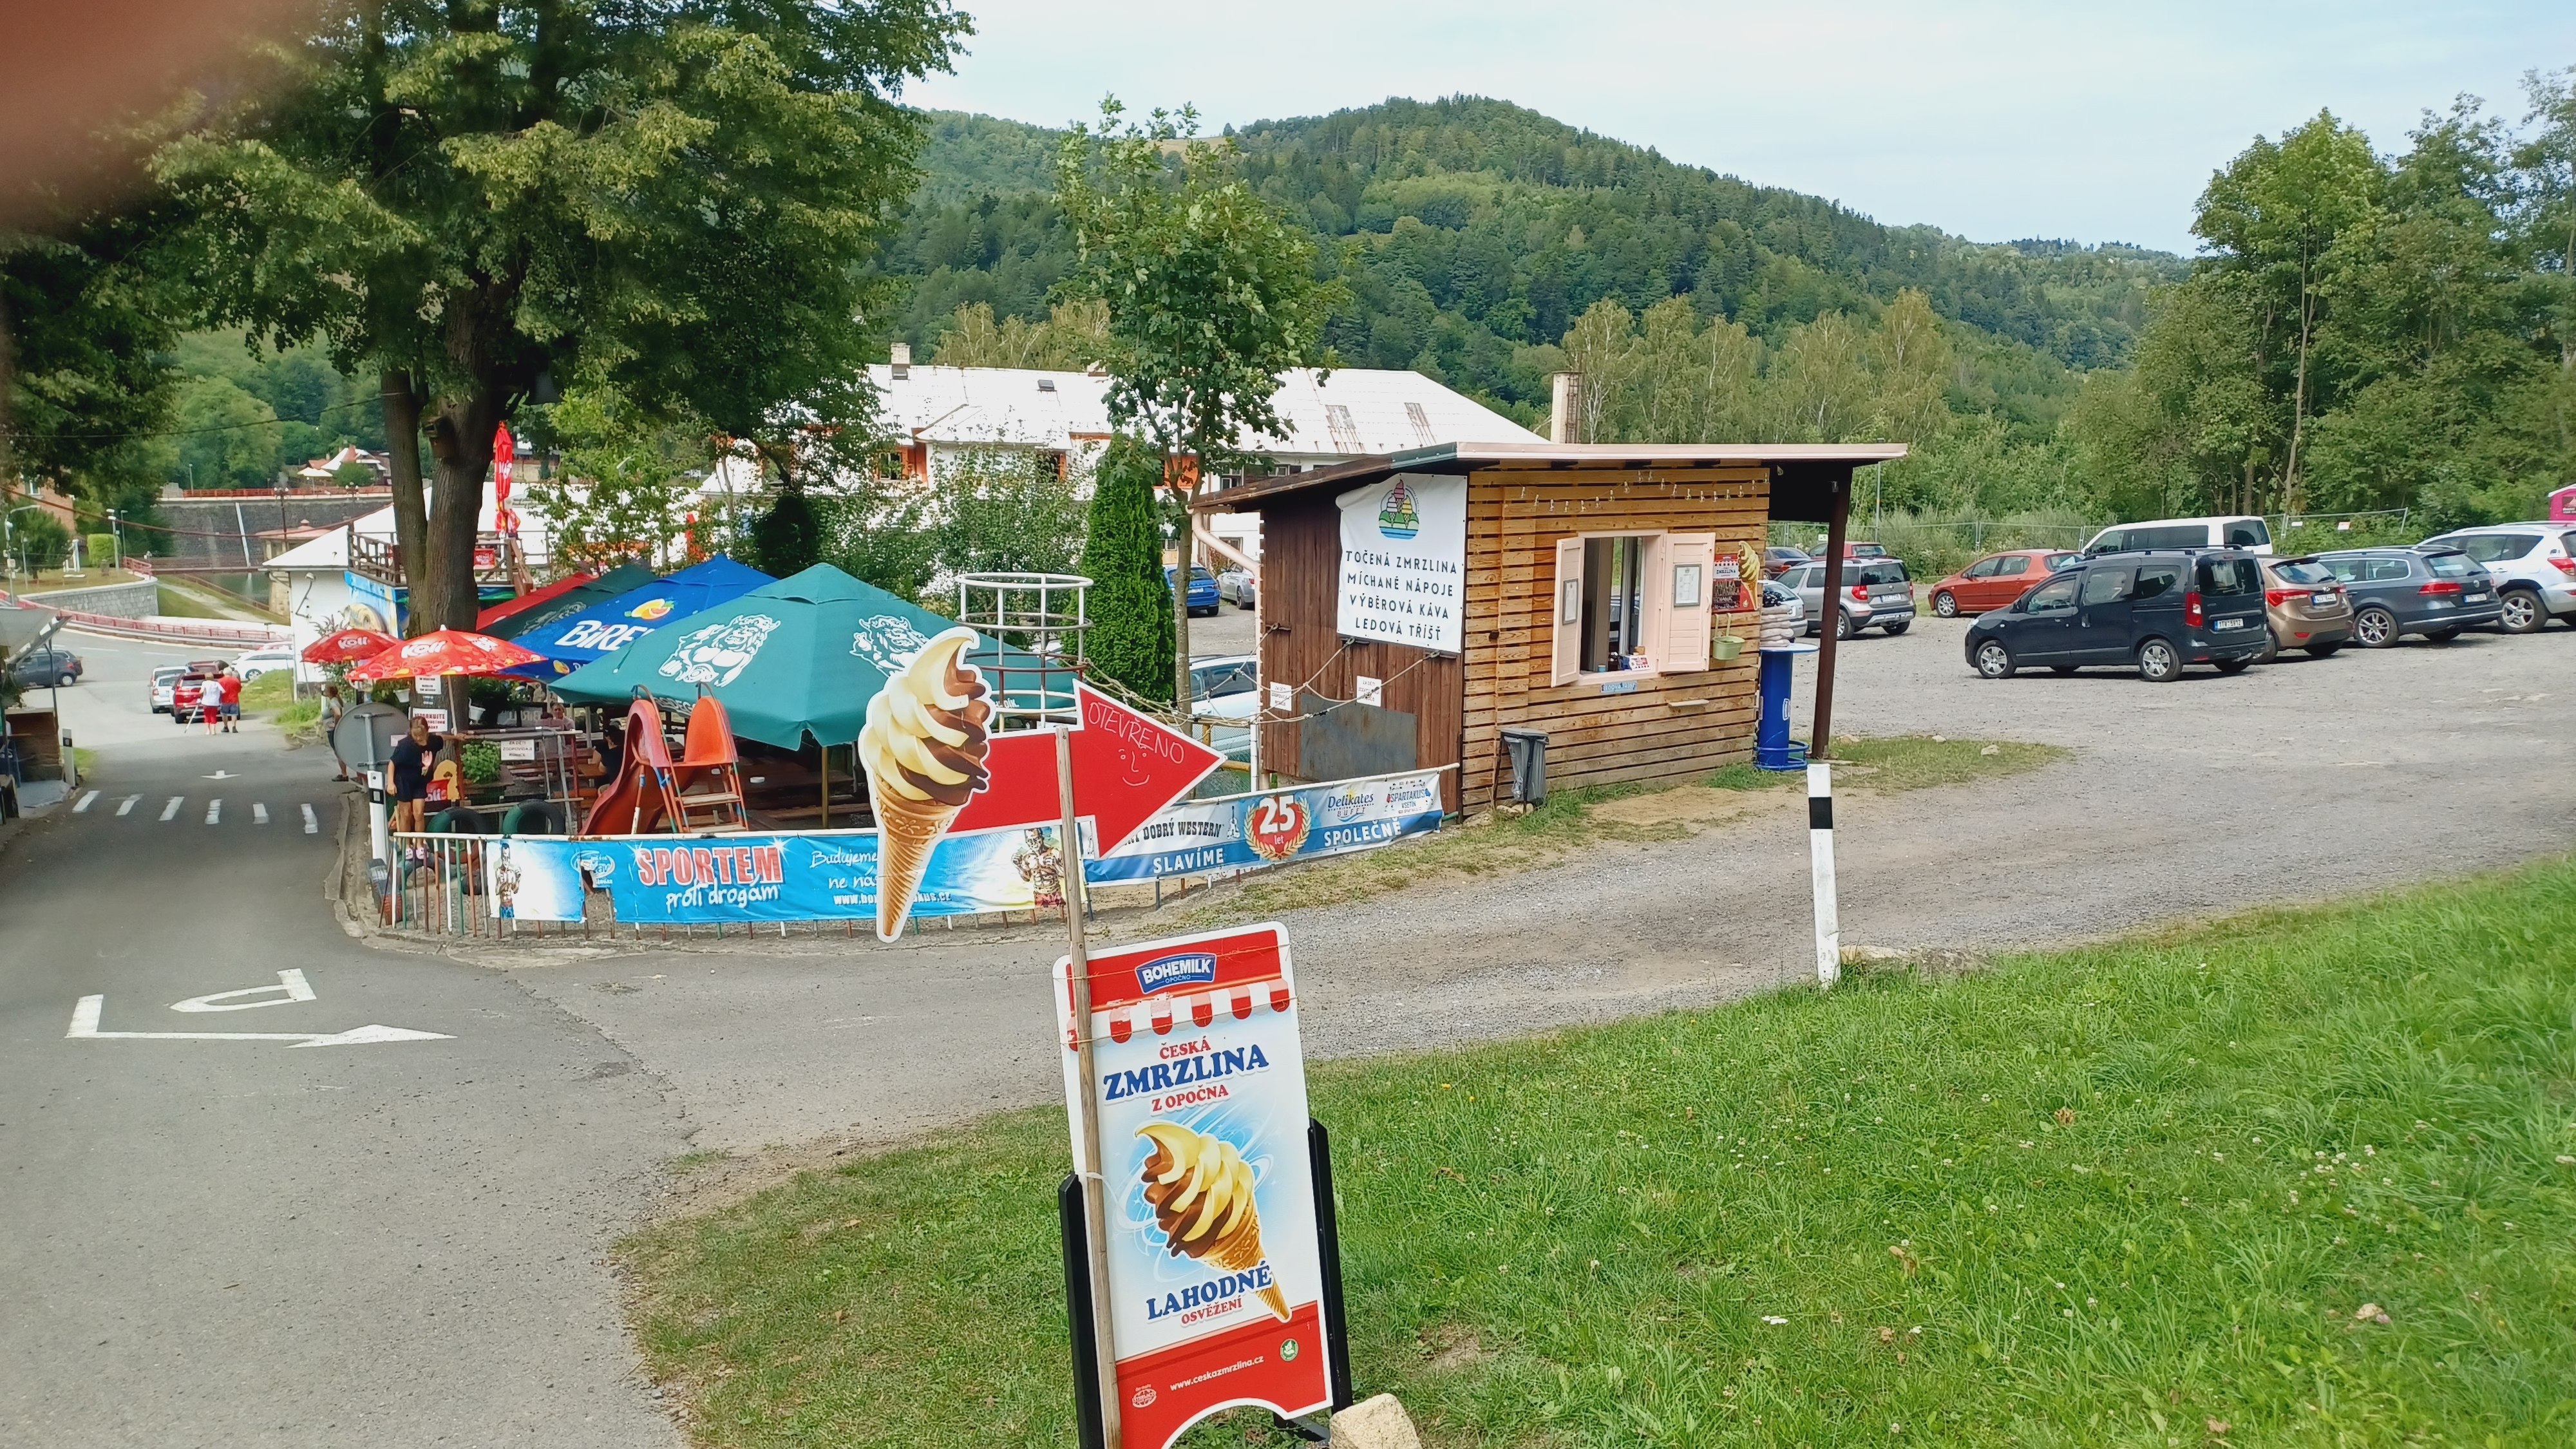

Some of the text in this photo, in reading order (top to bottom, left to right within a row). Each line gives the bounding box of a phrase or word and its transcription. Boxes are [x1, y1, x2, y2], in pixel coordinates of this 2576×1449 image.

[1346, 549, 1457, 574] TOČENÁ ZMRZLINA
[1347, 571, 1453, 596] MÍCHANÉ NÁPOJE
[1350, 592, 1448, 620] VÝBĚROVÁ KÁVA
[1356, 616, 1441, 641] LEDOVÁ TŘÍŠŤ
[1088, 701, 1184, 764] OTEVŘENO
[1328, 793, 1374, 808] Delikates
[1390, 789, 1425, 802] SPARTAKUS
[1259, 795, 1296, 835] 25
[1337, 807, 1365, 817] BUFET
[1142, 817, 1175, 840] DOBRÝ
[1177, 821, 1222, 838] WESTERN
[1274, 835, 1284, 845] let
[1324, 817, 1401, 847] SPOLEČNĚ
[636, 846, 784, 886] SPORTEM
[1153, 848, 1224, 875] SLAVÍME
[666, 873, 779, 914] proti drogám
[828, 876, 848, 889] ne
[1142, 958, 1211, 985] BOHEMILK
[1164, 974, 1191, 984] OPOČNO
[1159, 1036, 1211, 1059] ČESKÁ
[1103, 1044, 1269, 1101] ZMRZLINA
[1151, 1084, 1229, 1112] Z OPOČNA
[1146, 1260, 1272, 1320] LAHODNÉ
[1180, 1295, 1242, 1325] OSVĚŽENÍ
[1170, 1356, 1264, 1391] www.ceskazmrzlina.cz
